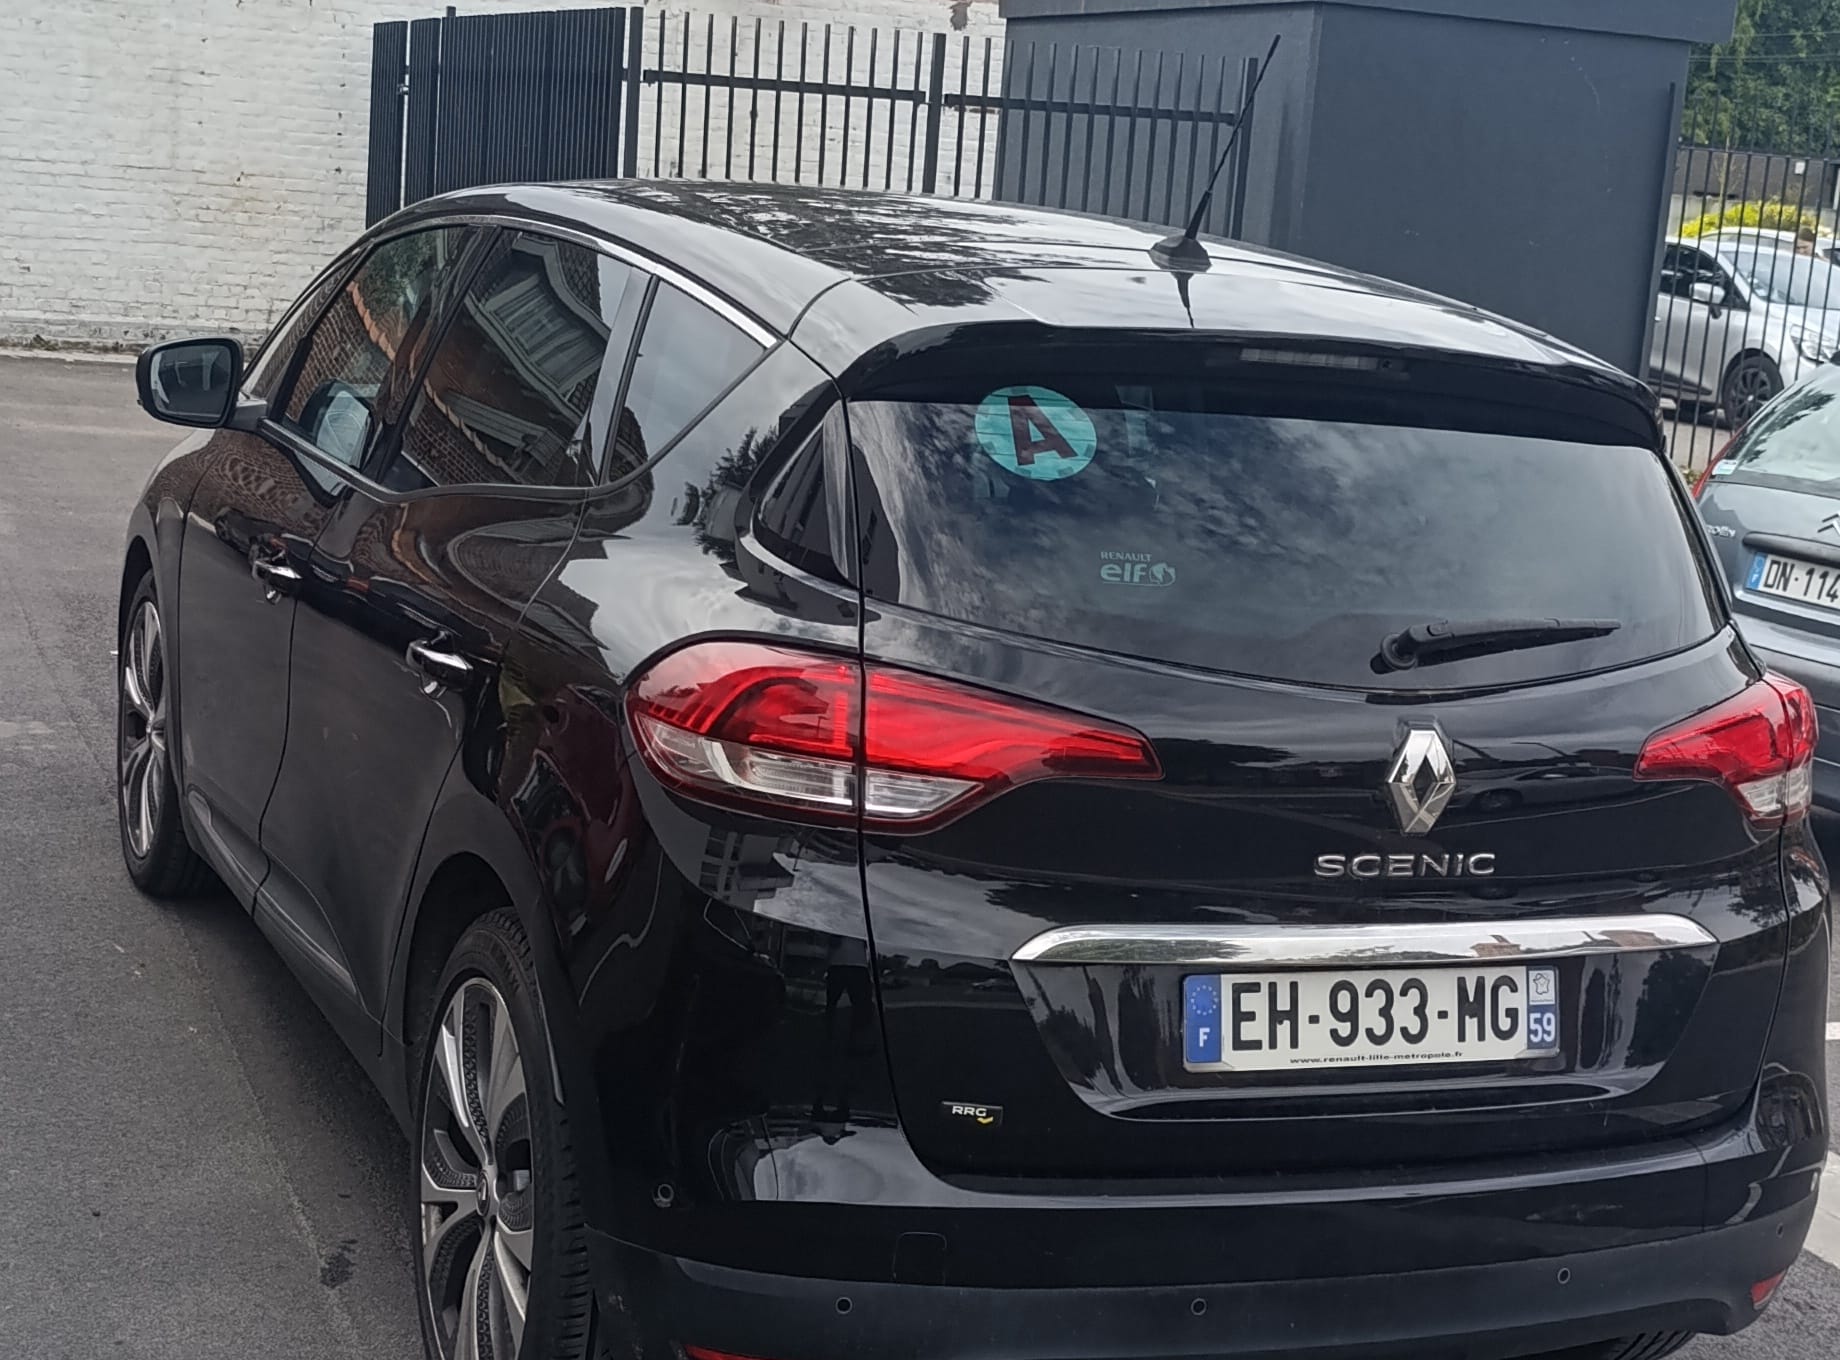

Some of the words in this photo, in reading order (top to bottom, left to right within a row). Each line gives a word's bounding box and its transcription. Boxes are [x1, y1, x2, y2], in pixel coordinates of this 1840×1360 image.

[1007, 395, 1078, 466] A
[1100, 551, 1152, 562] RENAULT
[1100, 562, 1148, 583] elf
[1314, 853, 1495, 878] SCENIC
[1199, 1027, 1210, 1048] F
[1231, 975, 1519, 1051] EH-933-MG
[1529, 1012, 1556, 1043] 59
[1289, 1051, 1463, 1065] www.renault-lille-metropole.fr
[952, 1105, 987, 1117] RRG
